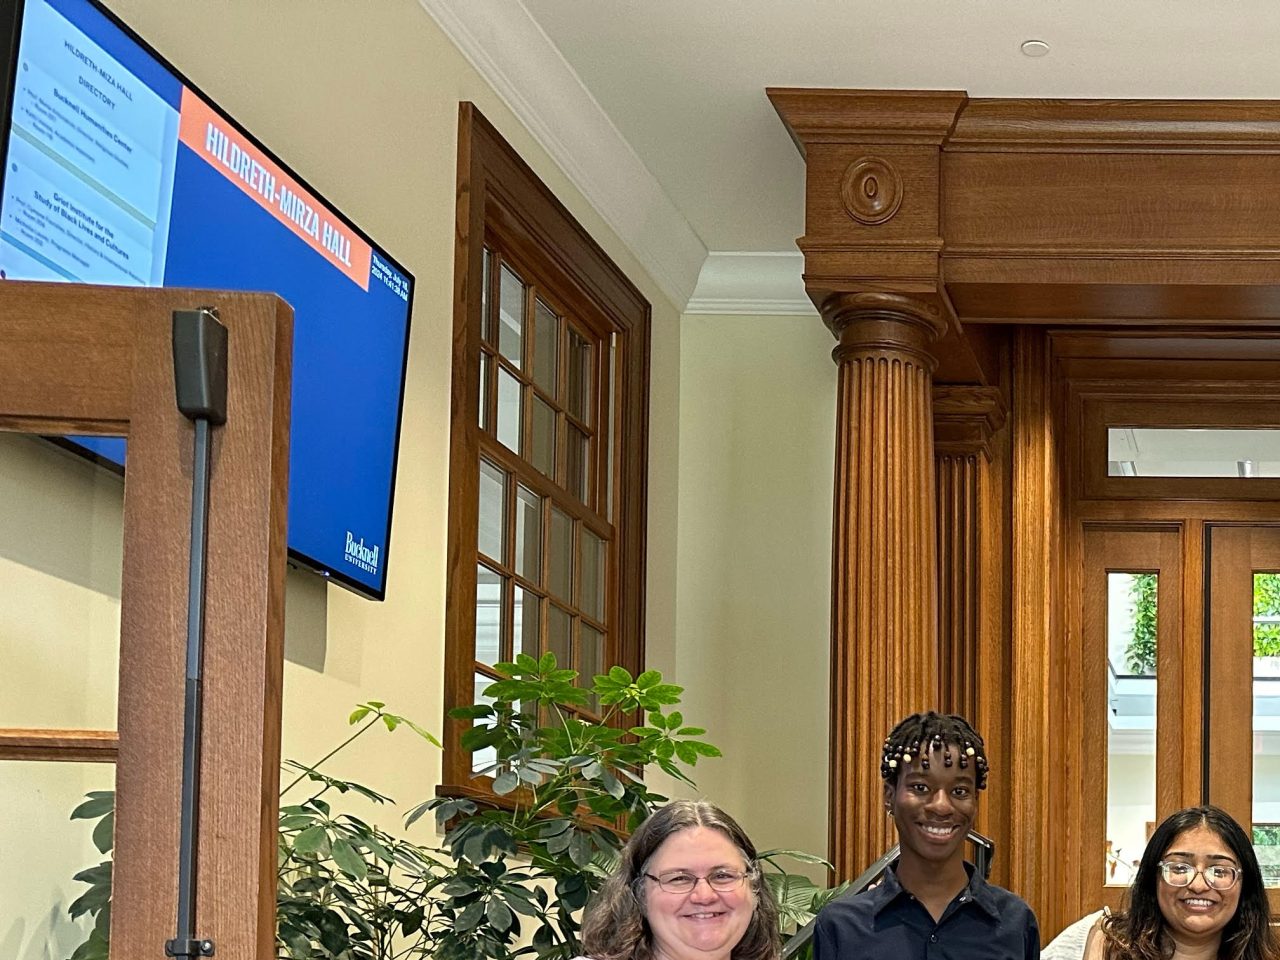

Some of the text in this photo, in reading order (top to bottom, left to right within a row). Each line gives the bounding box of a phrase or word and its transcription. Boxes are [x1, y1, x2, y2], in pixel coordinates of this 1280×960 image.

[78, 75, 116, 110] DIRECTORY
[116, 82, 133, 102] HALL
[53, 88, 80, 114] Bucknell
[80, 109, 114, 139] Humanities
[113, 134, 133, 153] Center
[206, 122, 320, 242] HILDRETH-MIRZA
[322, 220, 352, 268] HALL
[34, 190, 53, 210] Study
[53, 205, 61, 213] of
[60, 208, 78, 226] Black
[78, 219, 93, 236] Lives
[93, 232, 105, 244] and
[105, 238, 130, 260] Cultures
[69, 203, 95, 226] Institute
[95, 220, 104, 231] for
[104, 226, 114, 239] the
[371, 265, 384, 281] 2024
[392, 273, 402, 287] July
[344, 530, 379, 568] Bucknell
[344, 553, 378, 575] UNIVERSITY
